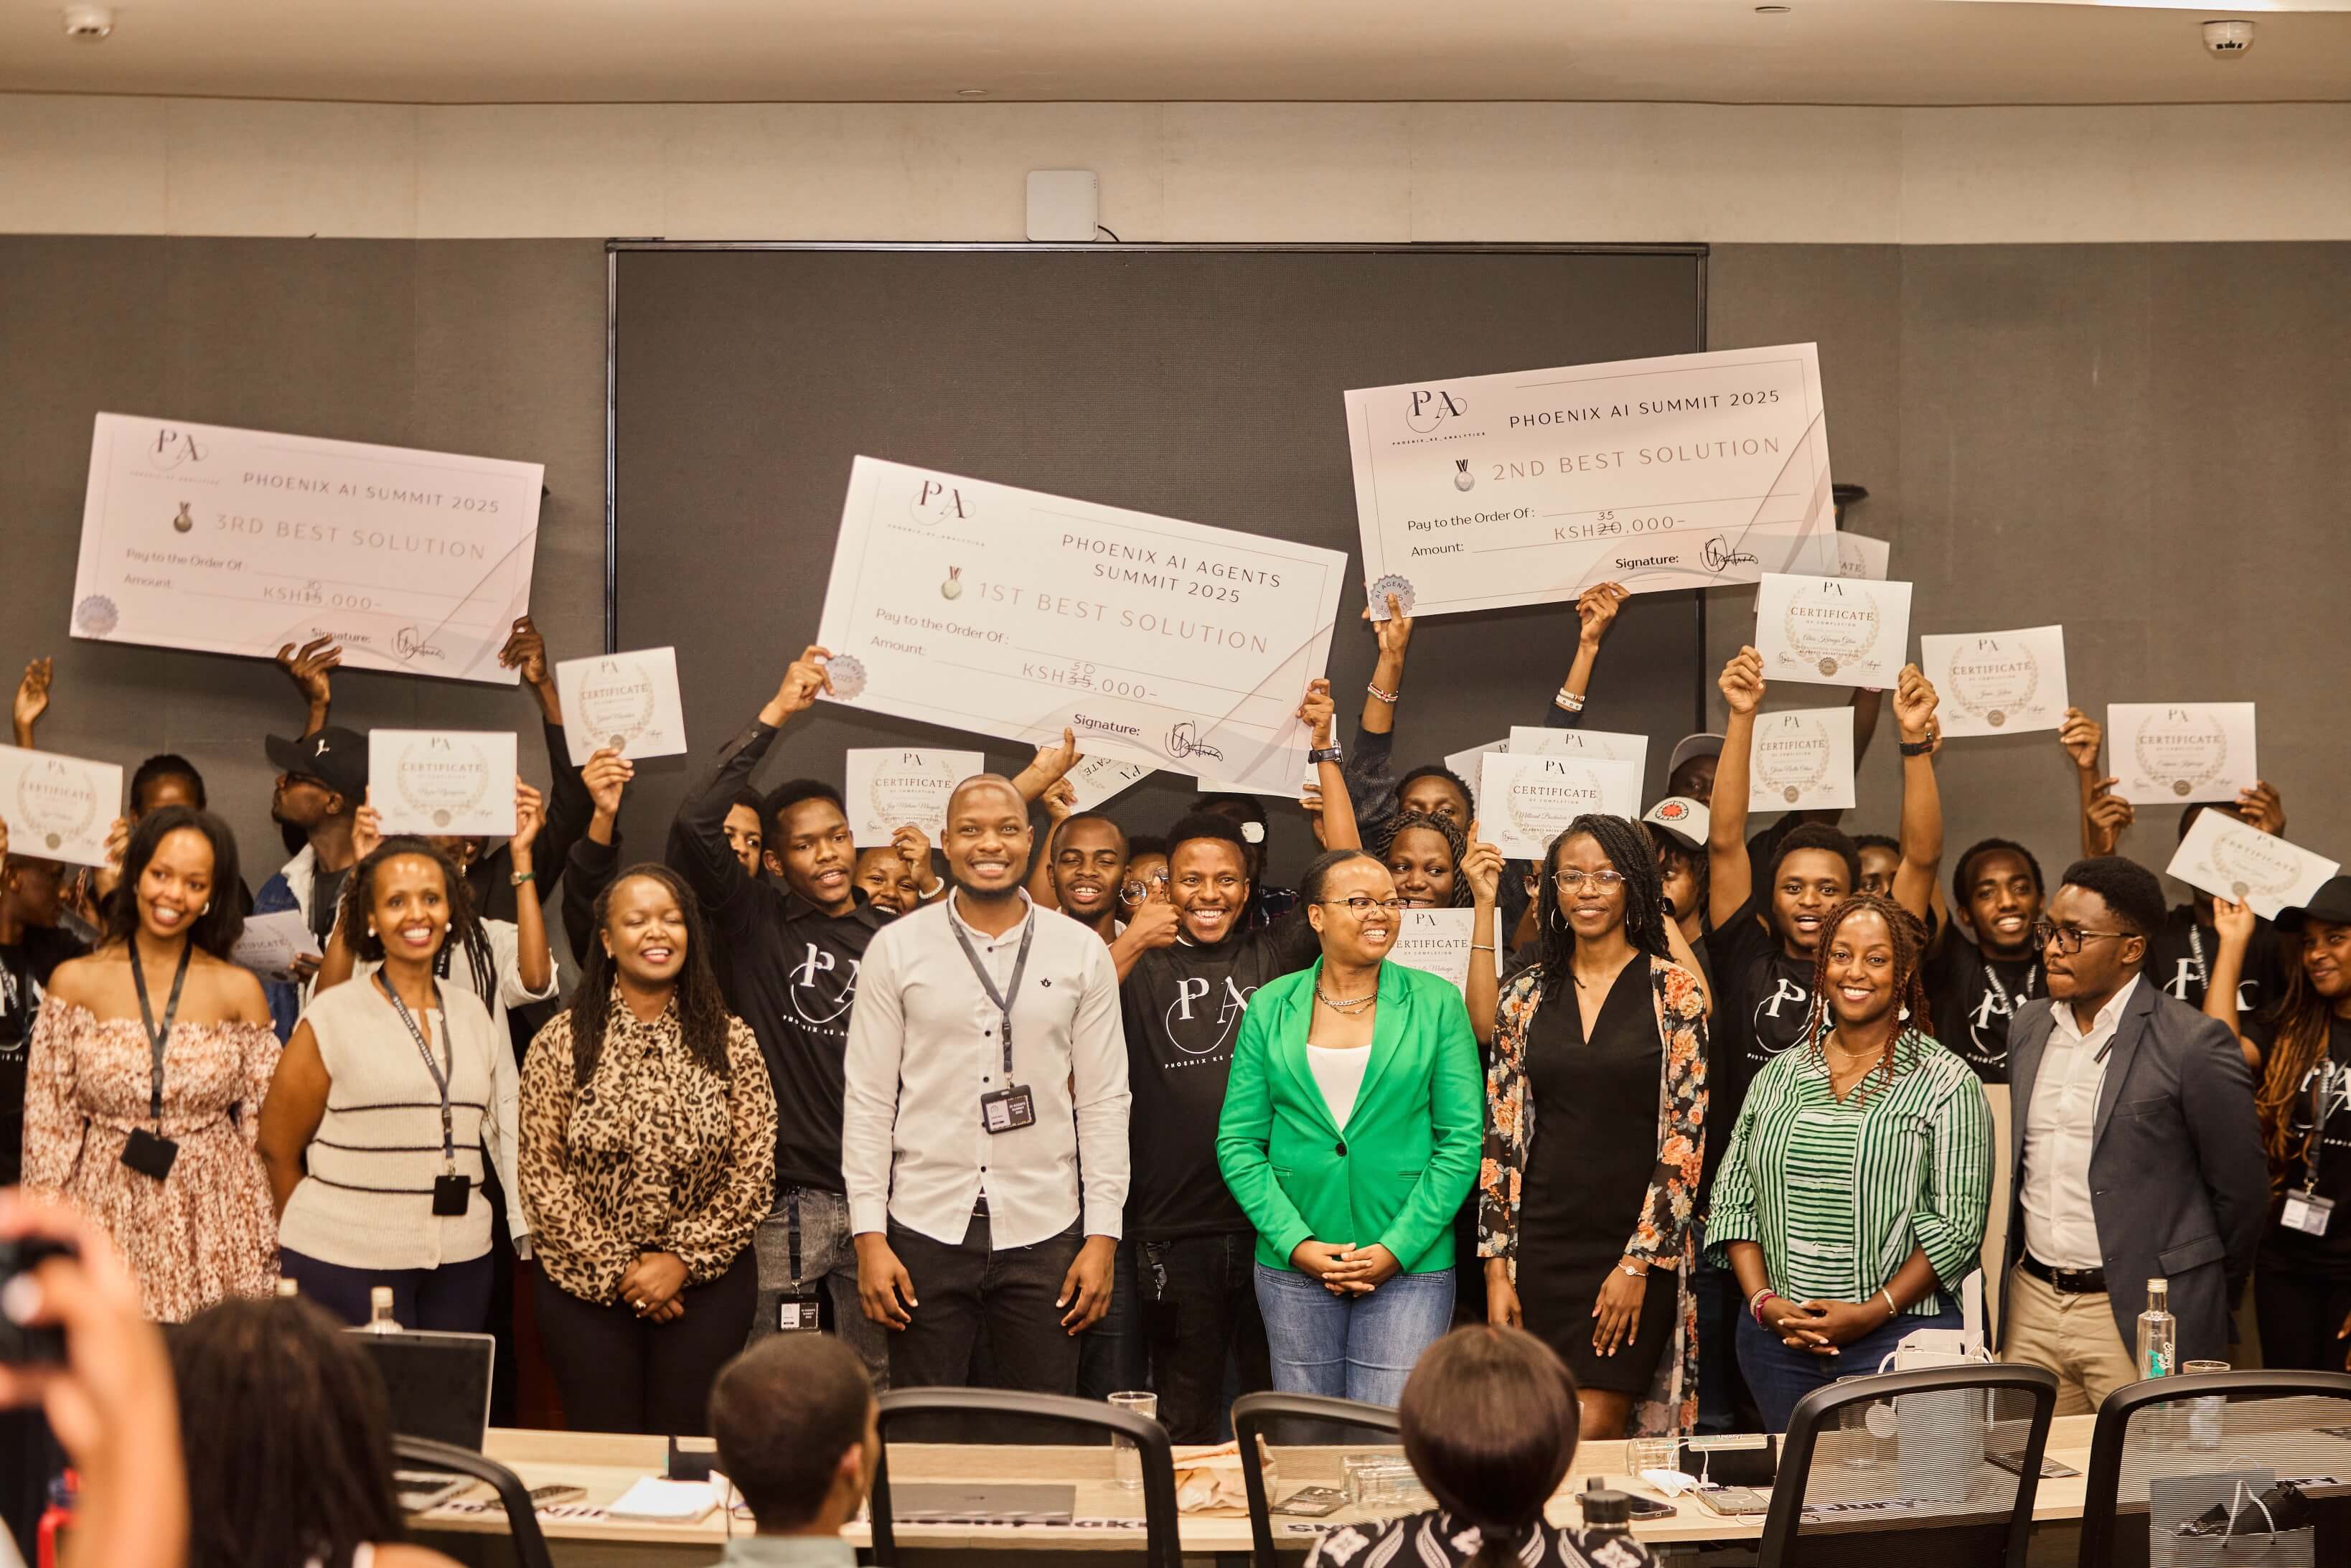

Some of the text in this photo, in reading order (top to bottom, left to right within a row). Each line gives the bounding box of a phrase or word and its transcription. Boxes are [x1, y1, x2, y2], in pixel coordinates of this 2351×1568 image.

[1406, 390, 1467, 428] PA
[1509, 390, 1780, 428] PHOENIX AI SUMMIT 2025
[151, 429, 207, 465] PA
[1492, 437, 1780, 481] 2ND BEST SOLUTION
[243, 471, 331, 494] PHOENIX
[339, 483, 357, 497] AI
[366, 486, 444, 507] SUMMIT
[451, 496, 500, 514] 2025
[913, 481, 973, 522] PA
[1407, 519, 1432, 532] Pay
[1434, 517, 1447, 528] to
[1451, 515, 1472, 526] the
[1475, 510, 1511, 524] Order
[1597, 510, 1615, 521] 35
[215, 513, 487, 561] 3RD BEST SOLUTION
[1411, 542, 1465, 557] Amount:
[126, 548, 149, 563] Pay
[151, 551, 165, 562] to
[167, 553, 187, 565] the
[189, 555, 224, 569] Order
[1062, 533, 1281, 588] PHOENIX AI AGENTS
[1615, 553, 1680, 570] Signature:
[1093, 563, 1242, 604] SUMMIT 2025
[1824, 581, 1843, 596] PA
[978, 582, 1270, 654] 1ST BEST SOLUTION
[1791, 607, 1874, 621] CERTIFICATE
[876, 608, 901, 625] Pay
[904, 615, 918, 626] to
[921, 618, 943, 631] the
[947, 622, 985, 639] Order
[871, 636, 926, 656] Amount:
[1953, 661, 2033, 675] CERTIFICATE
[581, 683, 649, 700] CERTIFICATE
[1074, 713, 1140, 736] Signature:
[1565, 733, 1583, 747] PA
[1760, 740, 1826, 751] CERTIFICATE
[2139, 735, 2221, 745] CERTIFICATE
[402, 763, 483, 772] CERTIFICATE
[903, 753, 922, 766] PA
[1545, 760, 1567, 775] PA
[875, 778, 952, 789] CERTIFICATE
[1513, 785, 1597, 798] CERTIFICATE
[1416, 913, 1436, 926] PA
[1397, 939, 1468, 948] ERTIFICATE
[1168, 976, 1252, 1039] PA
[1165, 1058, 1206, 1069] PHOENIX
